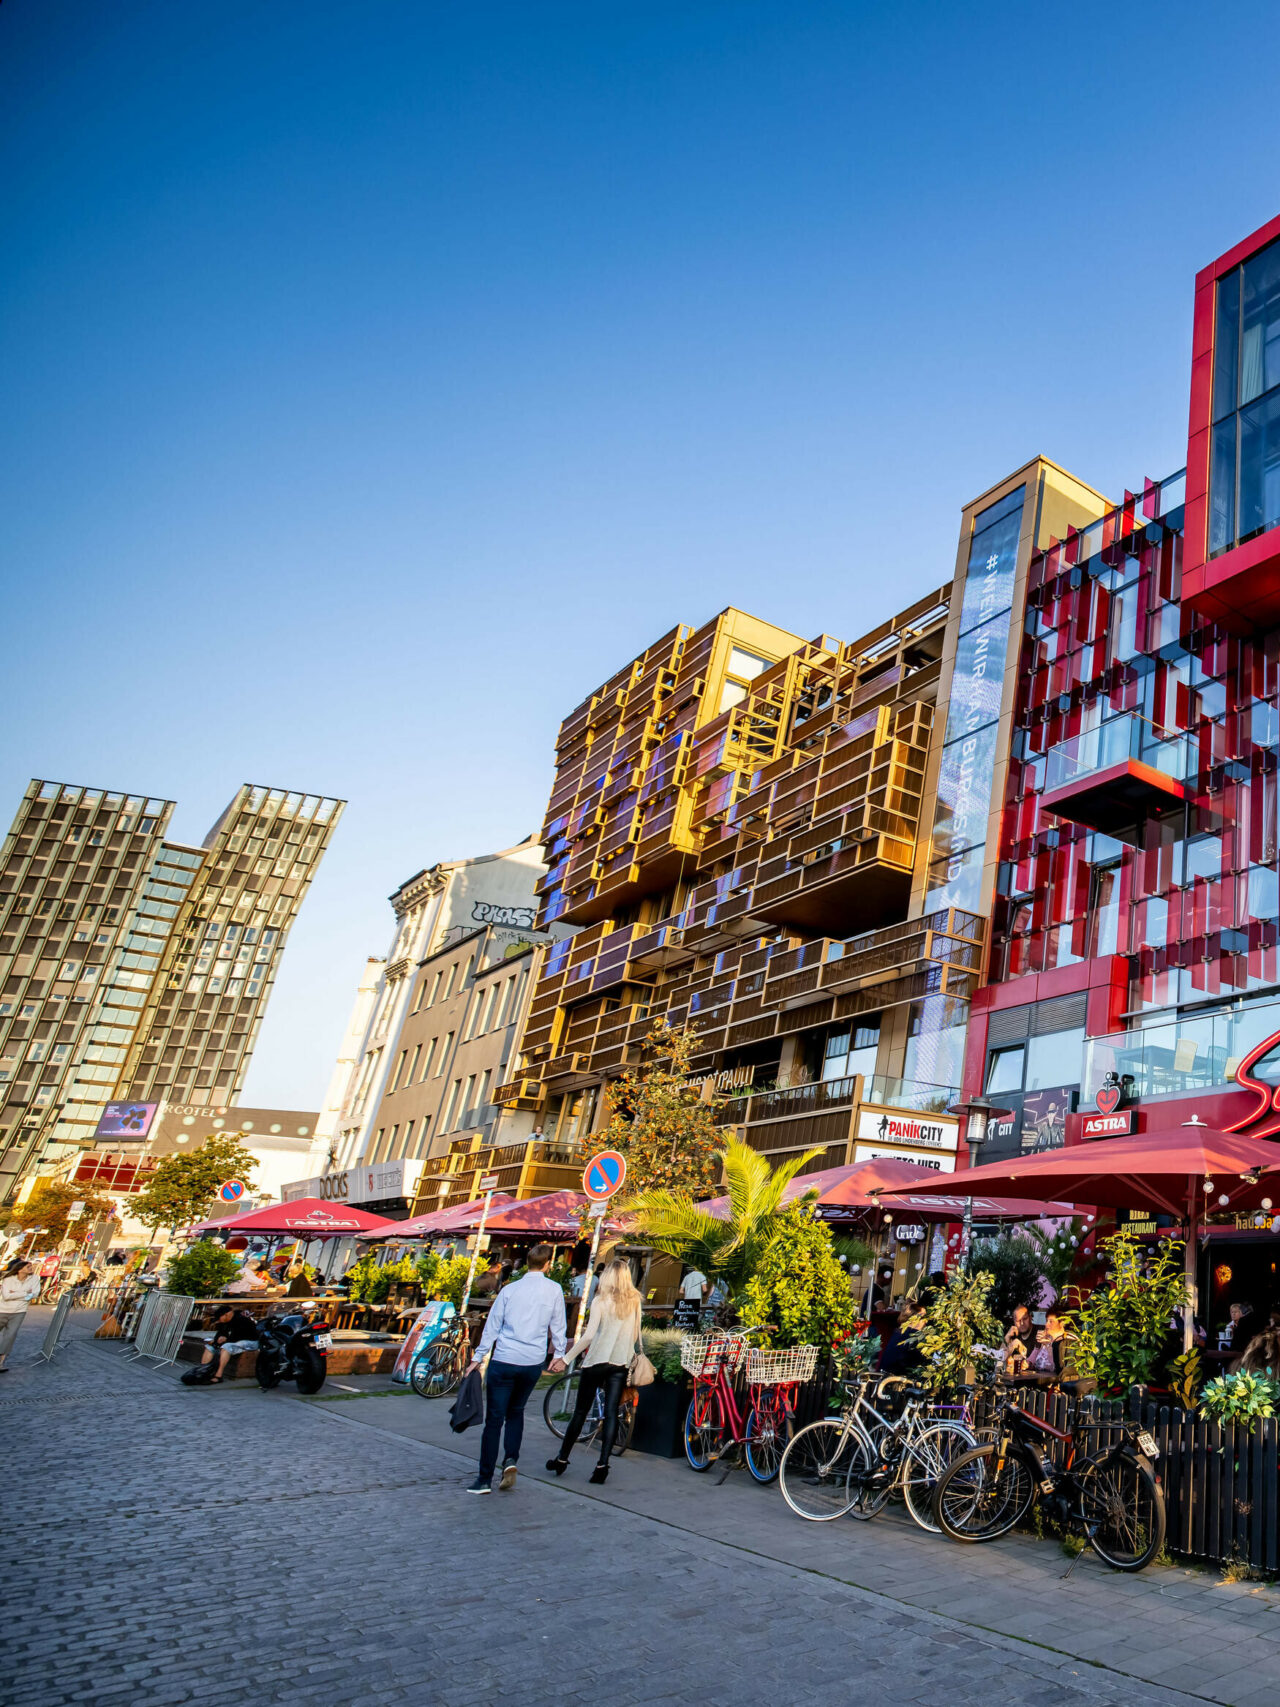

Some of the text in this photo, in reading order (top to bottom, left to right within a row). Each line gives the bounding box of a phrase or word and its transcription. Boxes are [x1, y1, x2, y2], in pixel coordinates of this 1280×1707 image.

[165, 1104, 217, 1118] RCOTEL
[998, 1122, 1013, 1136] CITY
[1085, 1116, 1127, 1133] ASTRA
[319, 1172, 349, 1200] DOCKS
[1121, 1222, 1157, 1234] RESTAURANT
